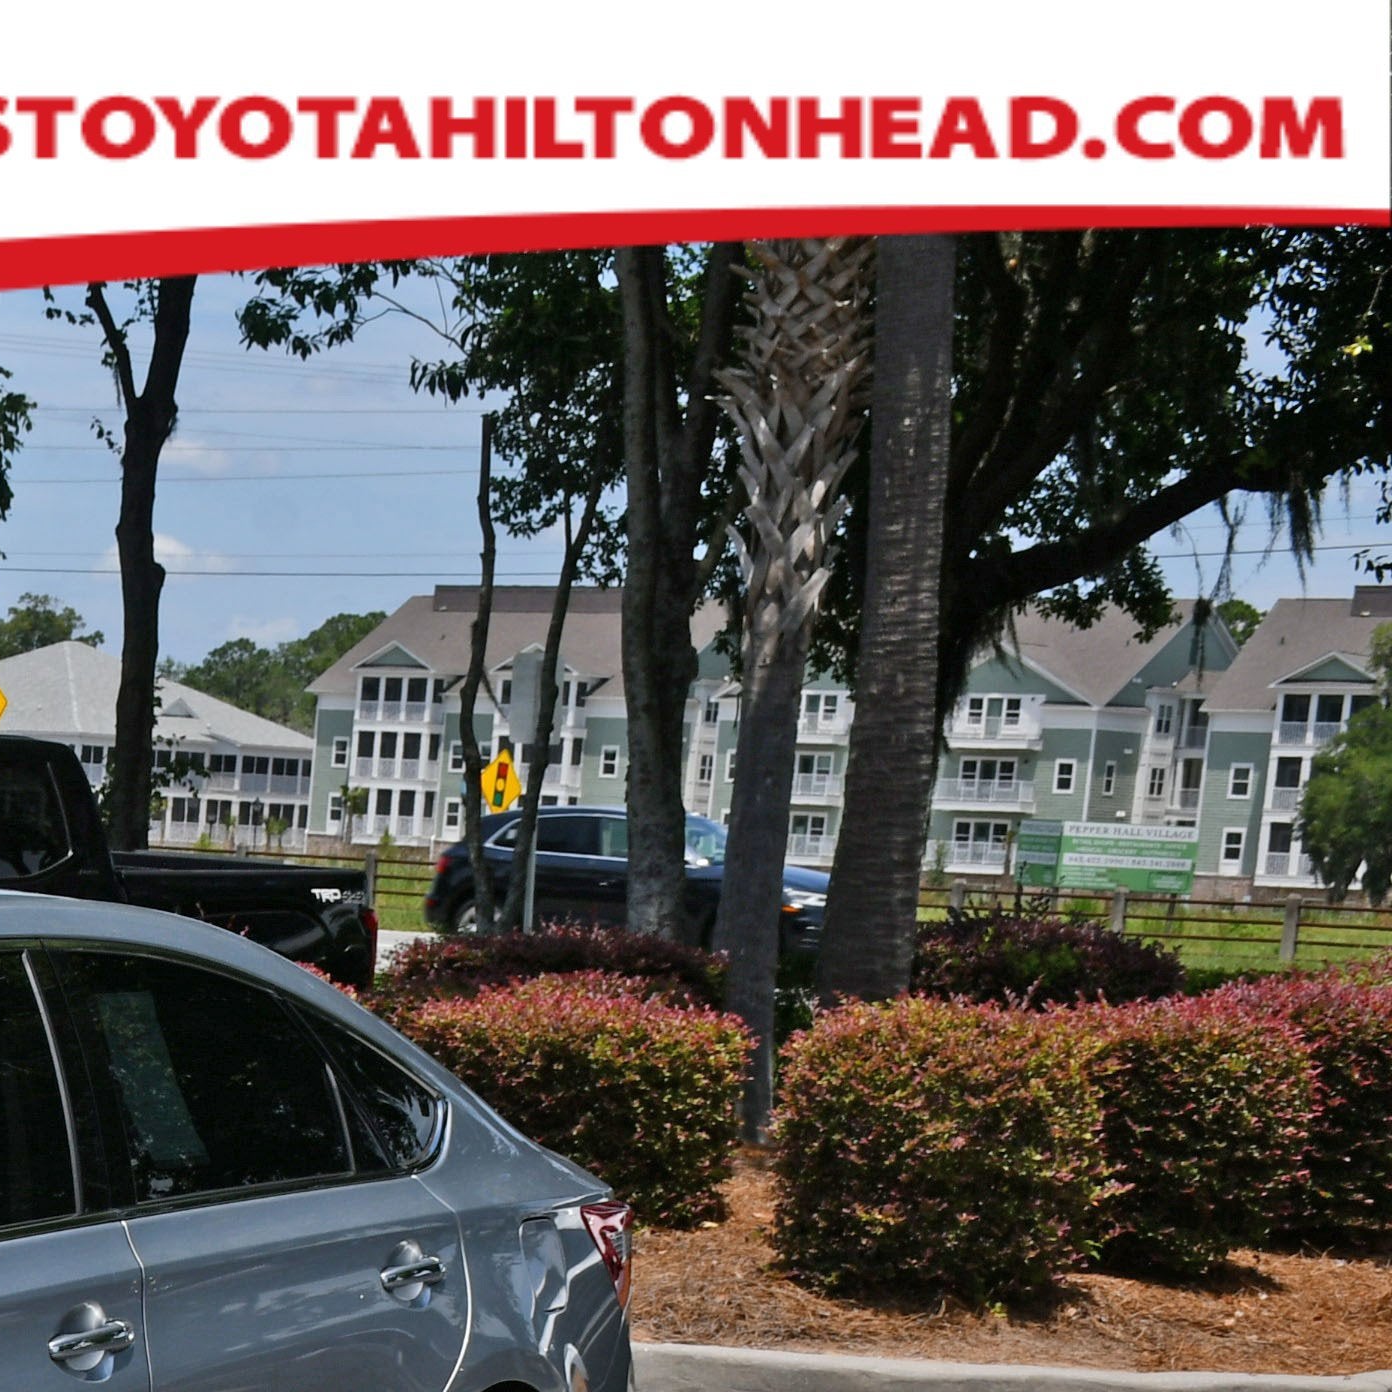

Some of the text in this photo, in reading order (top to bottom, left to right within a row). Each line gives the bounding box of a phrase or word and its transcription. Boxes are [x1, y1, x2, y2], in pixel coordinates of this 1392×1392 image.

[1068, 824, 1194, 840] PEPPER HALL VILLAGE
